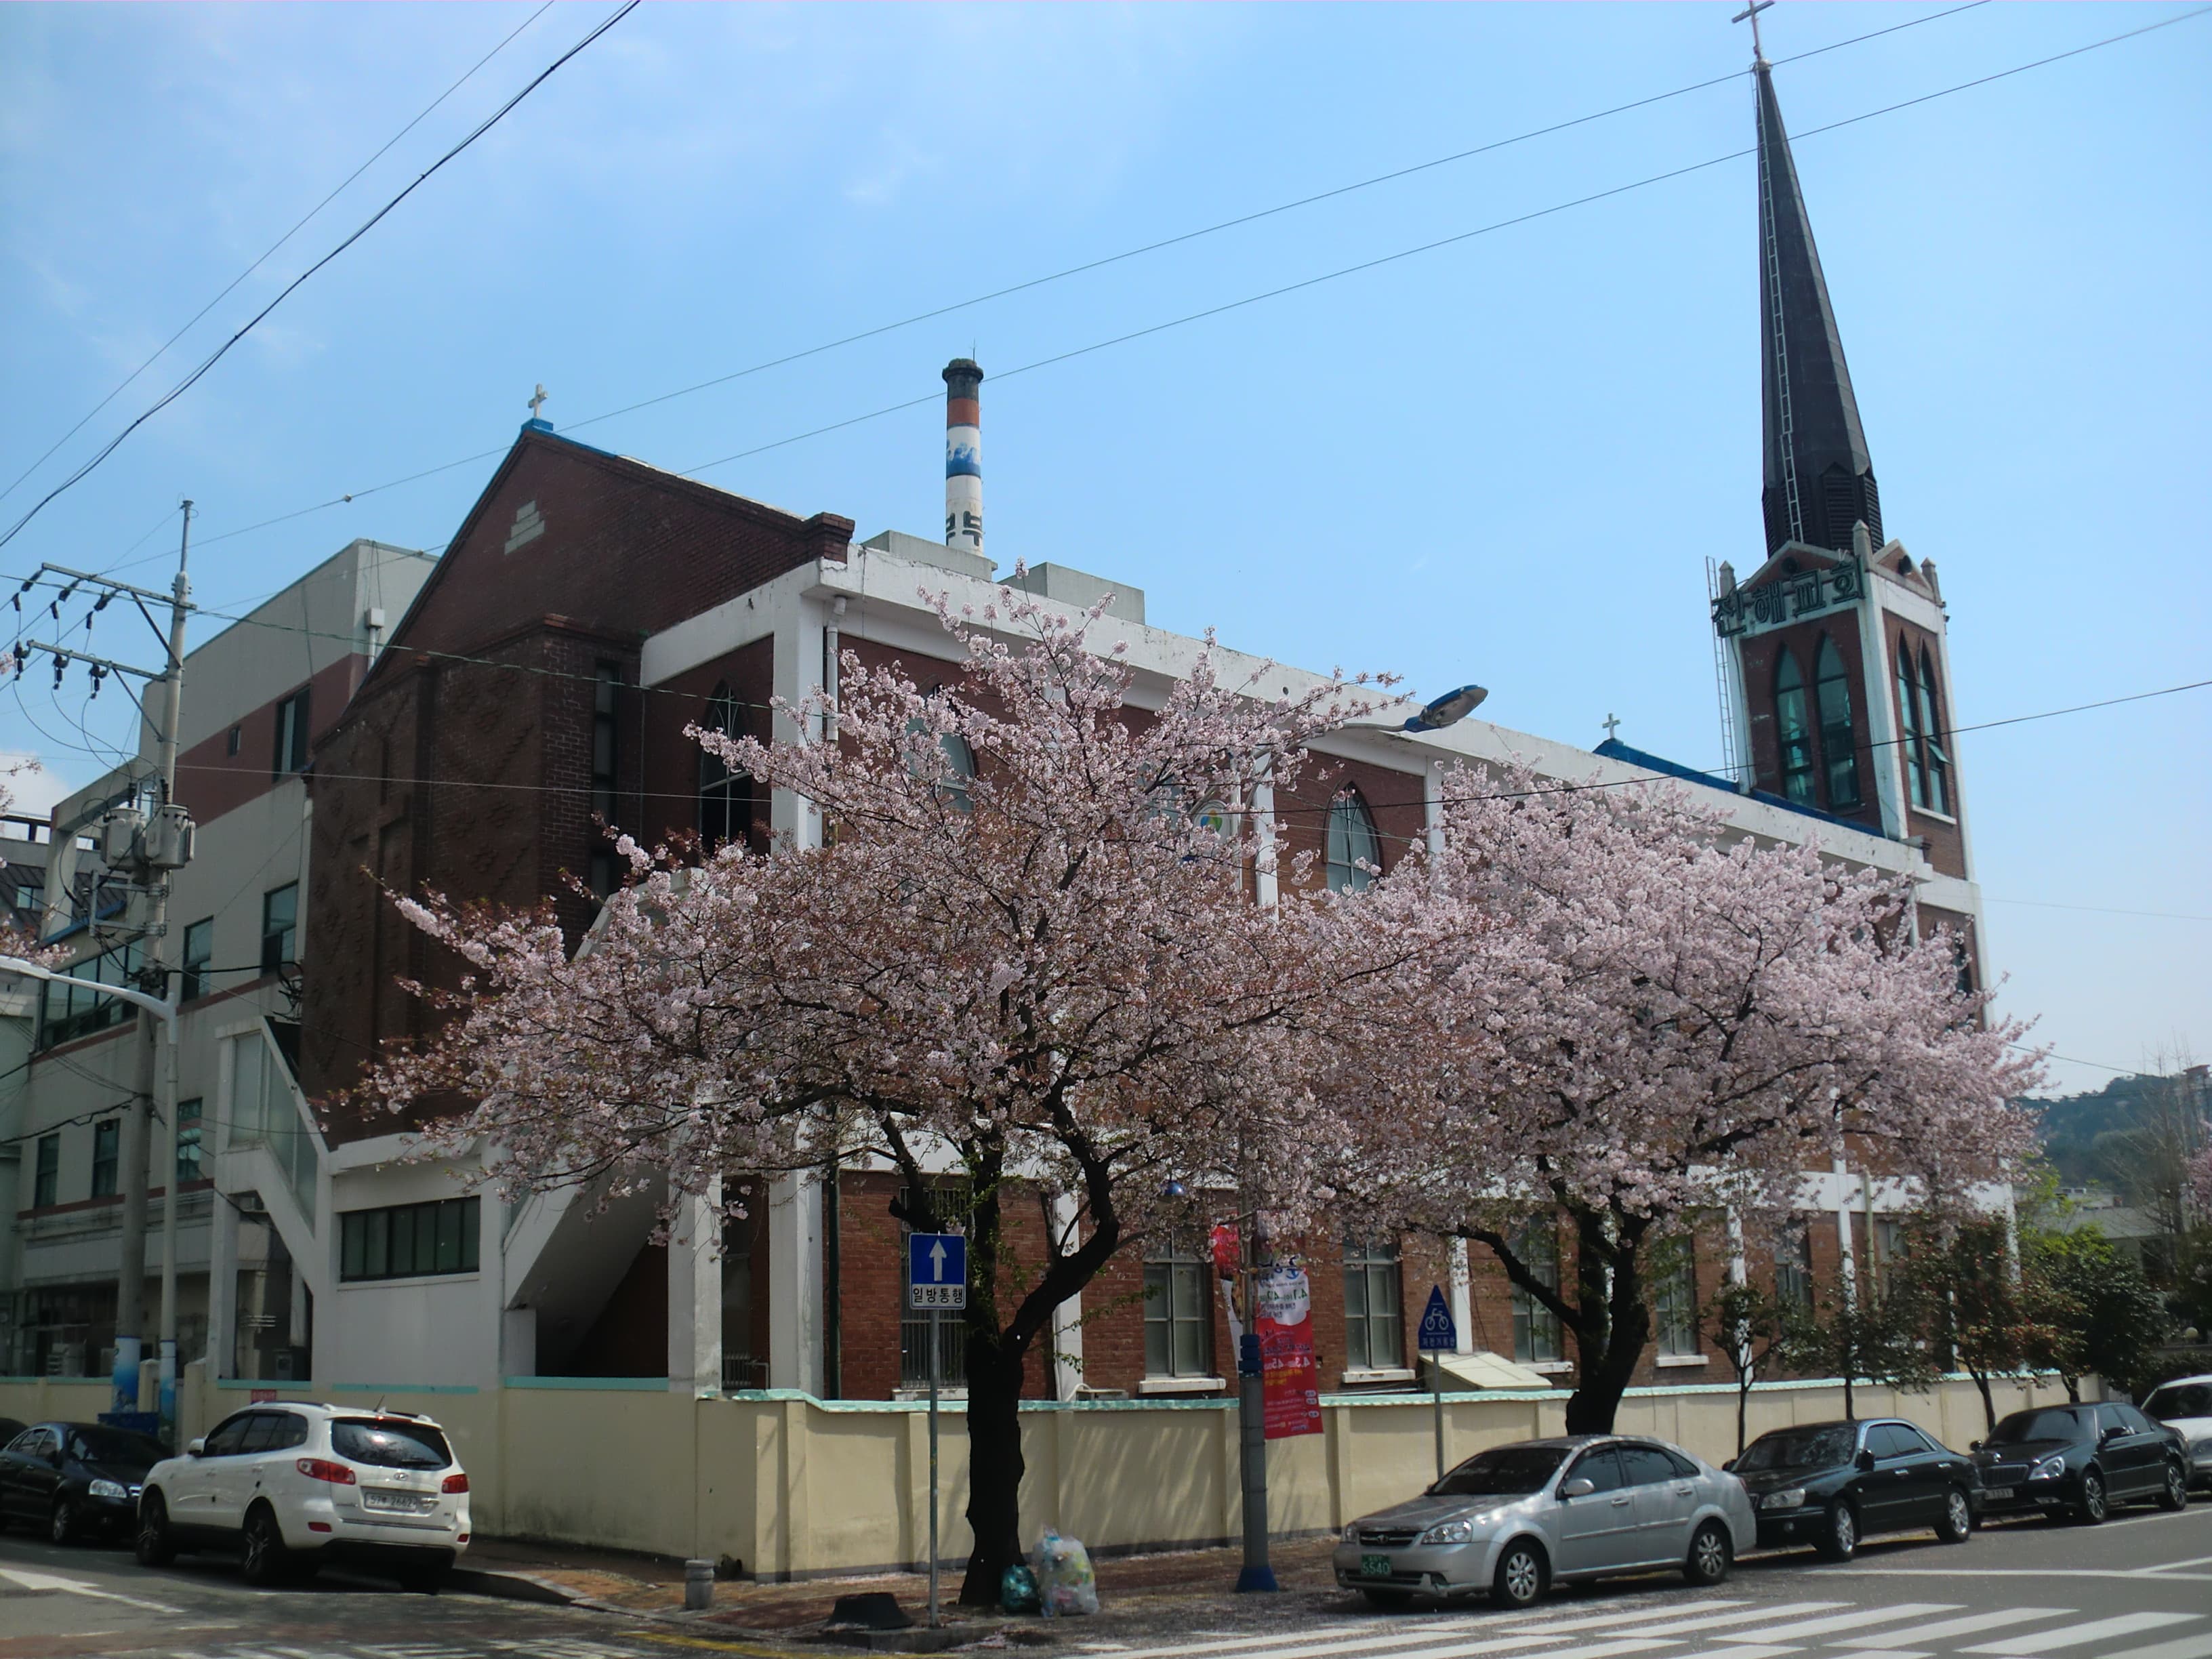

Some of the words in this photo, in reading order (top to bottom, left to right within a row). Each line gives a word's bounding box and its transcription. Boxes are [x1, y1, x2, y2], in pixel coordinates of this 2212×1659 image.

[1711, 555, 1865, 638] 진해교회
[913, 1288, 962, 1303] 일방통행
[1362, 1561, 1389, 1574] 5540
